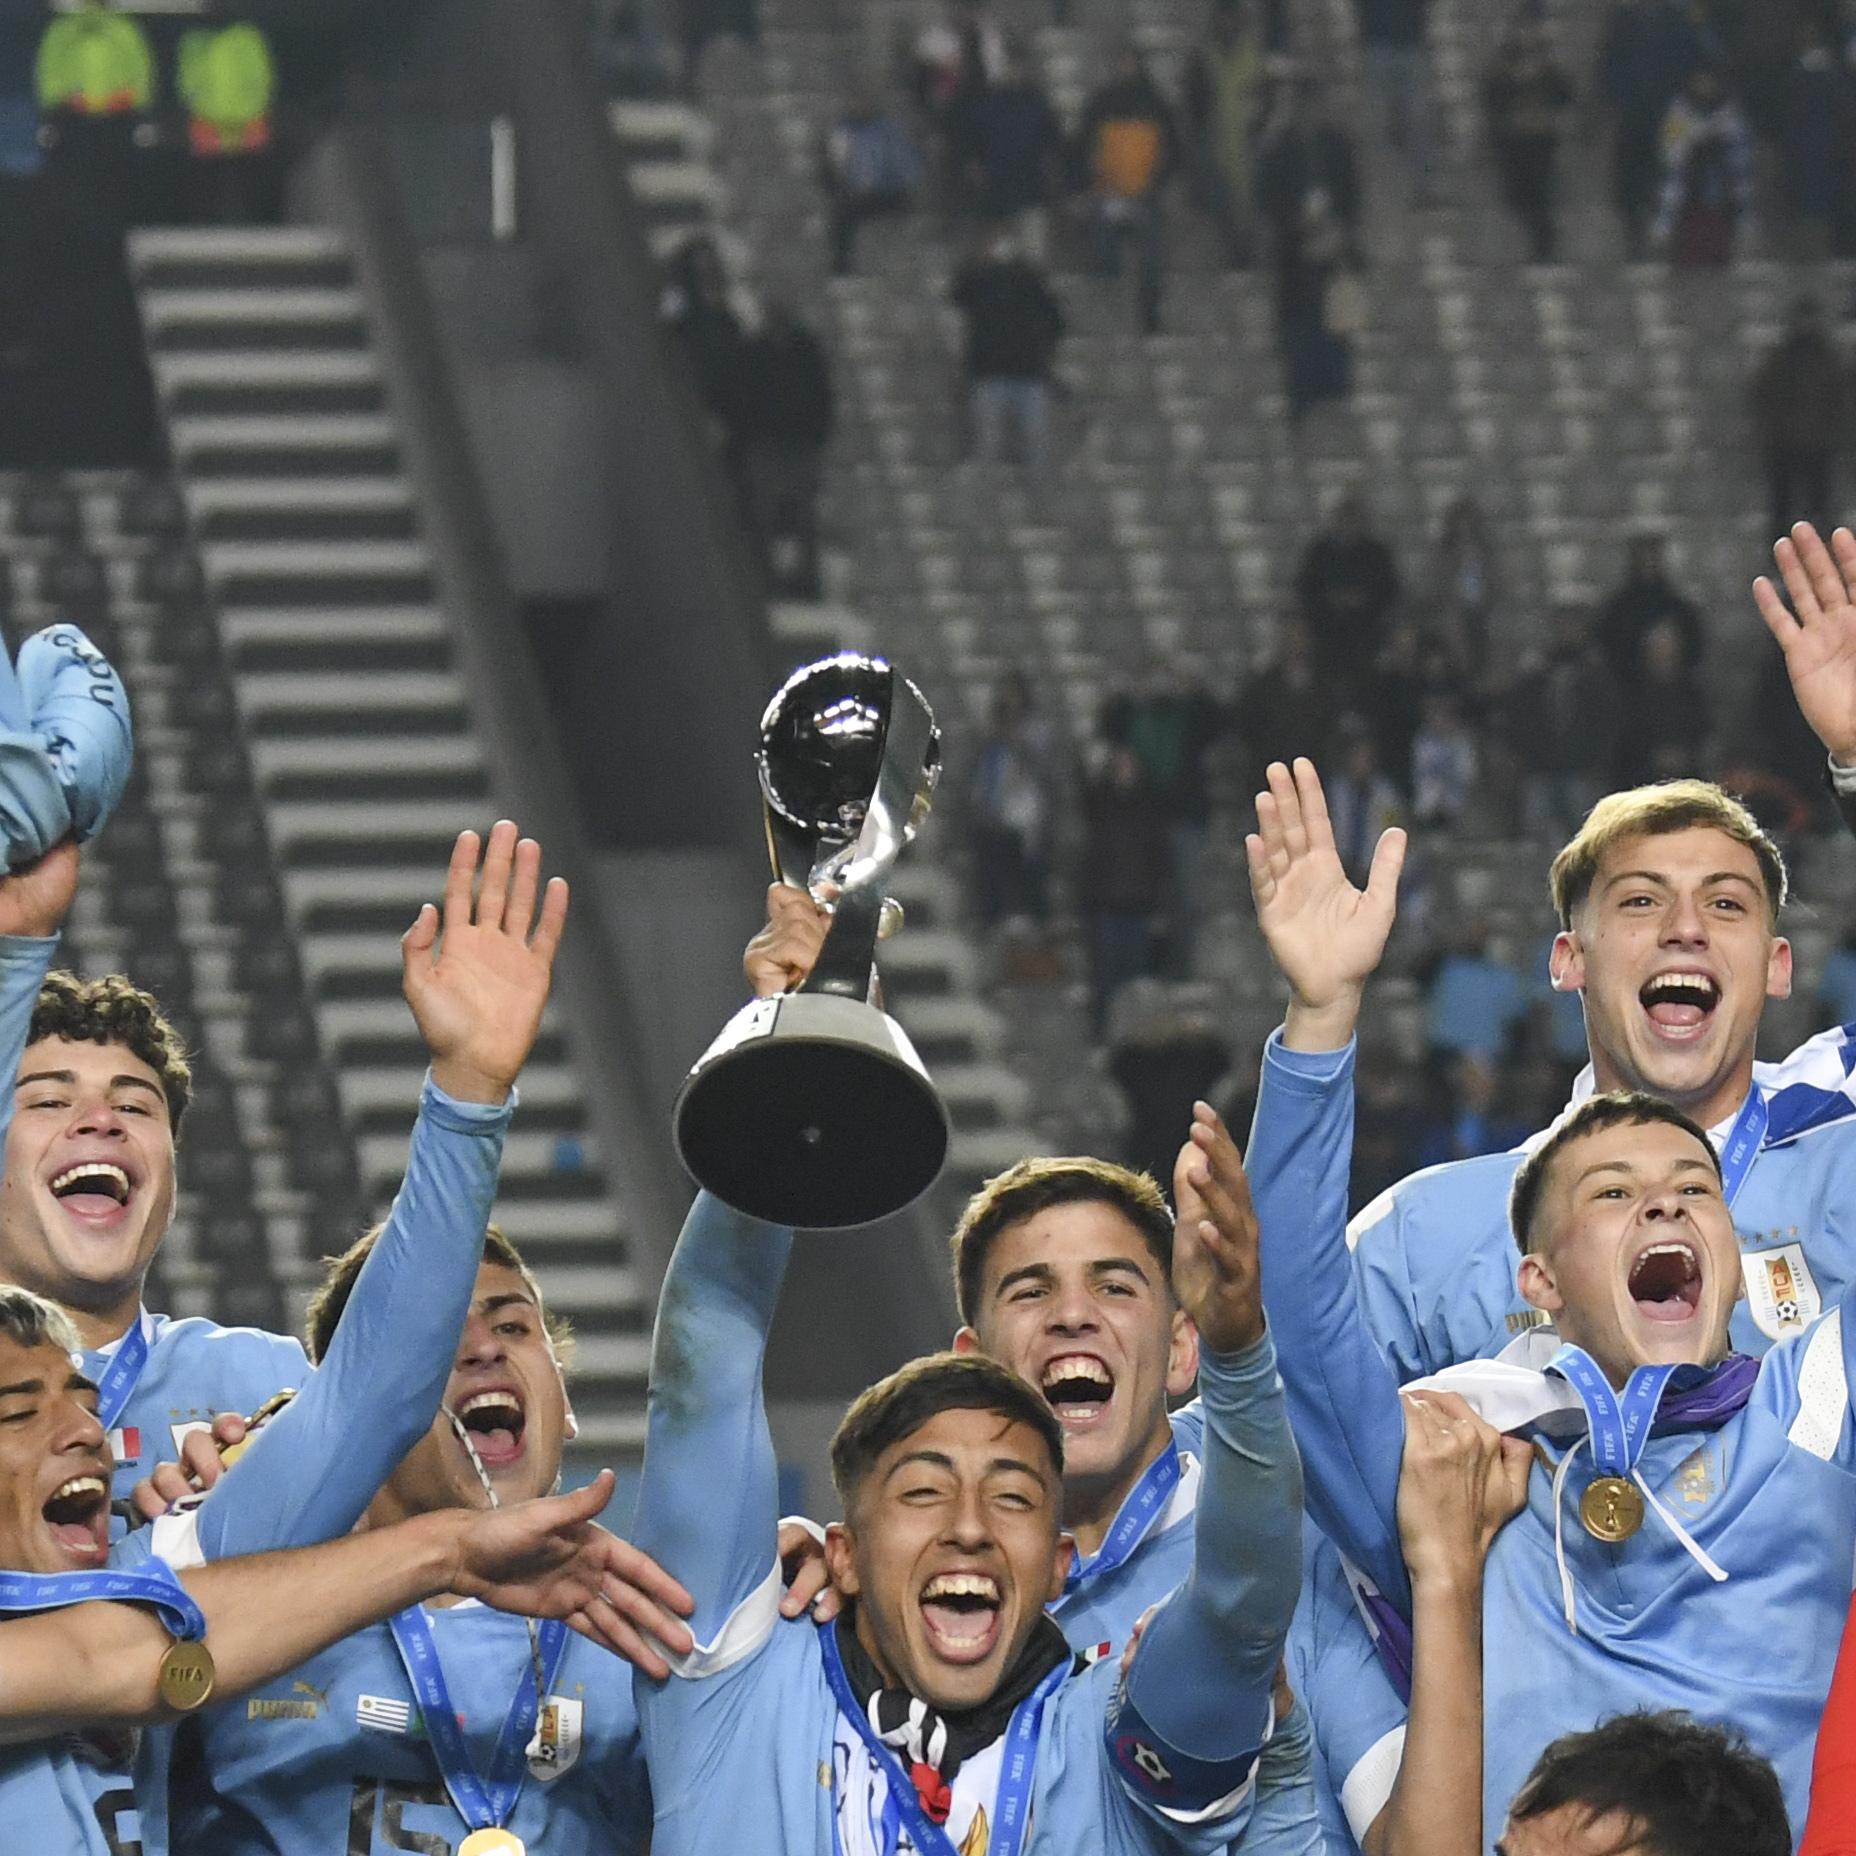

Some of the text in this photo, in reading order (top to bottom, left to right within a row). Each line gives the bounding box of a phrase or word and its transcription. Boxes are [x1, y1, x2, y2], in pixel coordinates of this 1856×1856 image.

[1638, 1373, 1655, 1397] FIFA
[1604, 1430, 1617, 1461] FIFA
[1118, 1517, 1138, 1545] FIFA
[169, 1667, 203, 1683] FIFA
[247, 1699, 318, 1721] PUMA
[1011, 1753, 1026, 1783] FIFA
